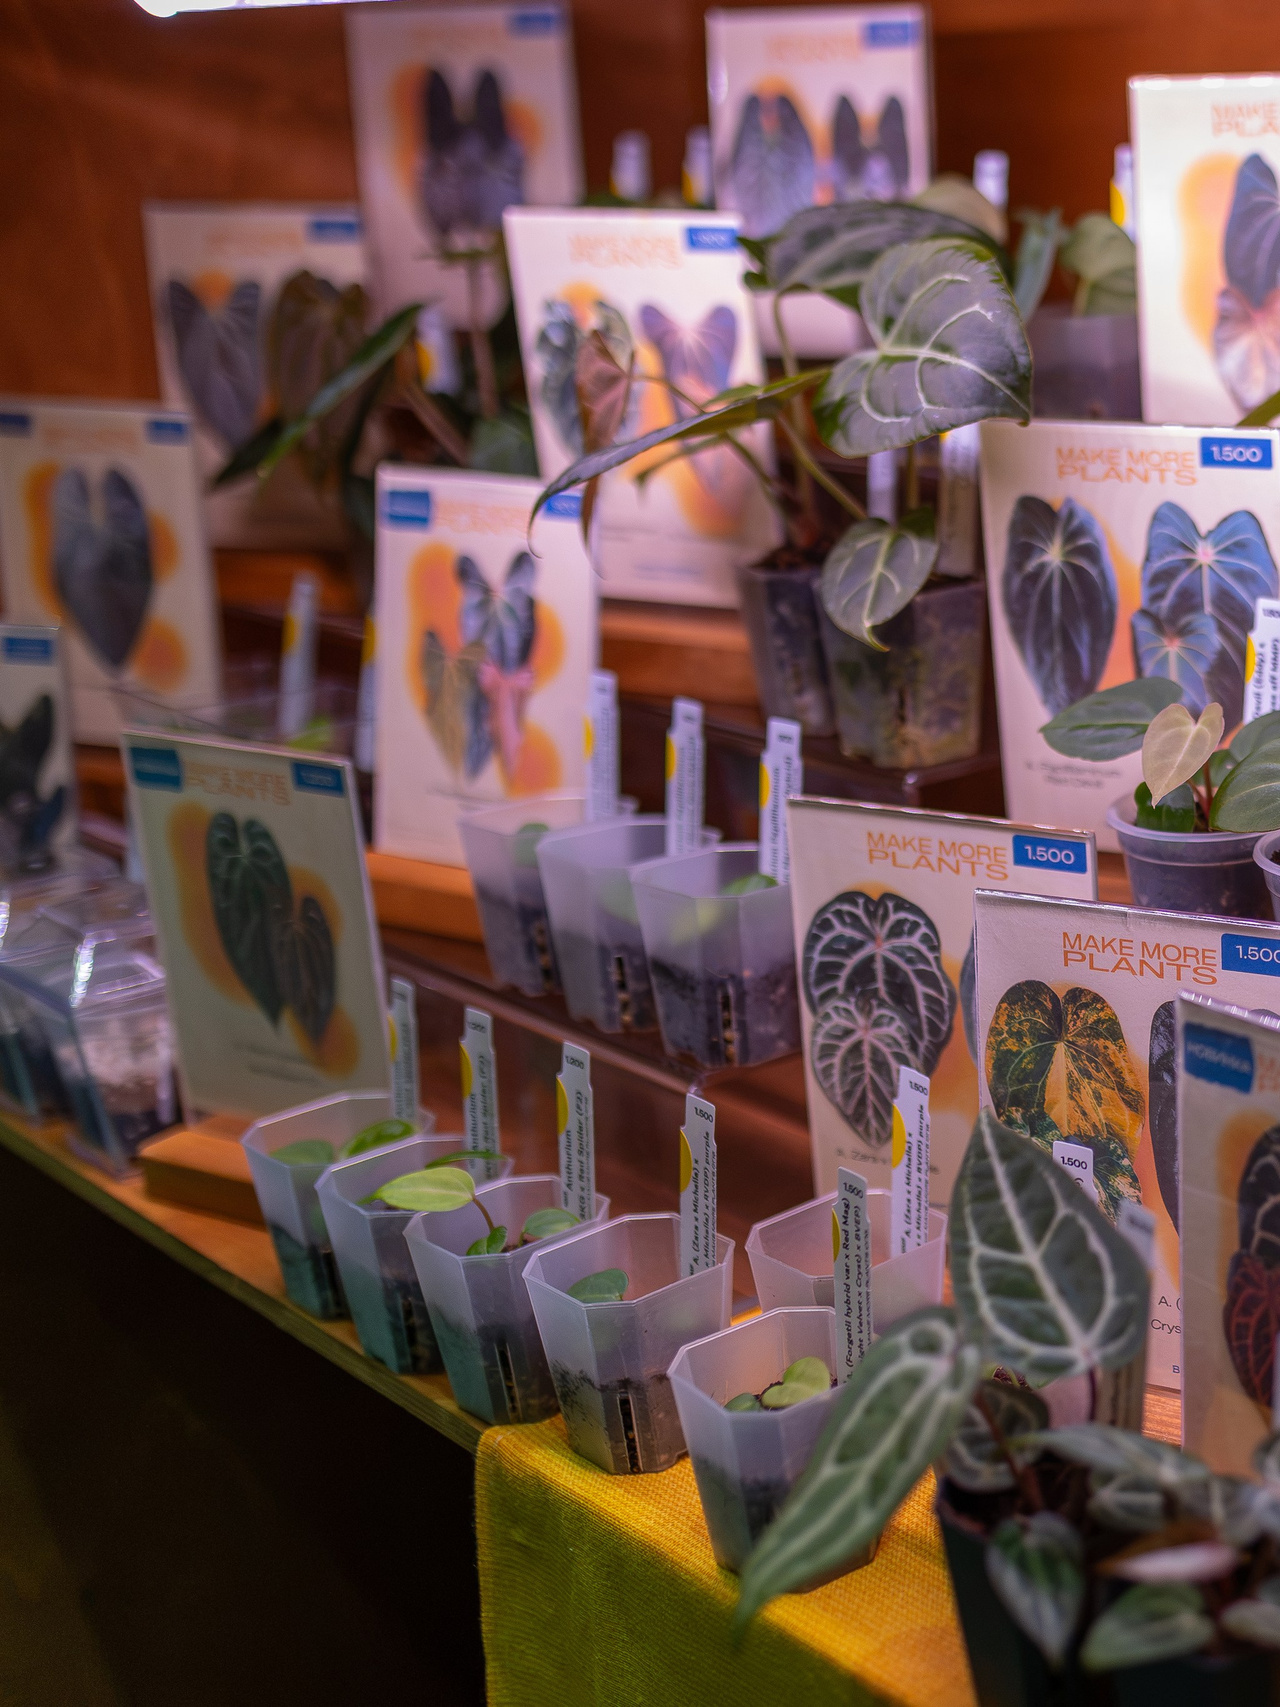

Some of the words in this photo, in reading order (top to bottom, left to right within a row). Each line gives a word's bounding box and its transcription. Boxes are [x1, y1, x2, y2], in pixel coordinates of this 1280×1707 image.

[1056, 447, 1121, 466] MAKE
[1127, 448, 1195, 470] MORE
[1210, 445, 1263, 463] 1.500
[1057, 463, 1198, 486] PLANTS
[866, 831, 932, 854] MAKE
[938, 840, 1008, 864] MORE
[1024, 845, 1075, 865] 1.500
[868, 848, 1009, 881] PLANTS
[1062, 931, 1134, 957] MAKE
[1141, 940, 1218, 968] MORE
[1063, 950, 1218, 986] PLANTS
[908, 1080, 929, 1096] 1.500
[694, 1107, 714, 1124] 1.500
[1060, 1156, 1088, 1170] 1.500
[841, 1197, 852, 1227] Mag)
[841, 1229, 850, 1250] Red
[1157, 1295, 1172, 1308] A.
[1150, 1318, 1181, 1335] Crys
